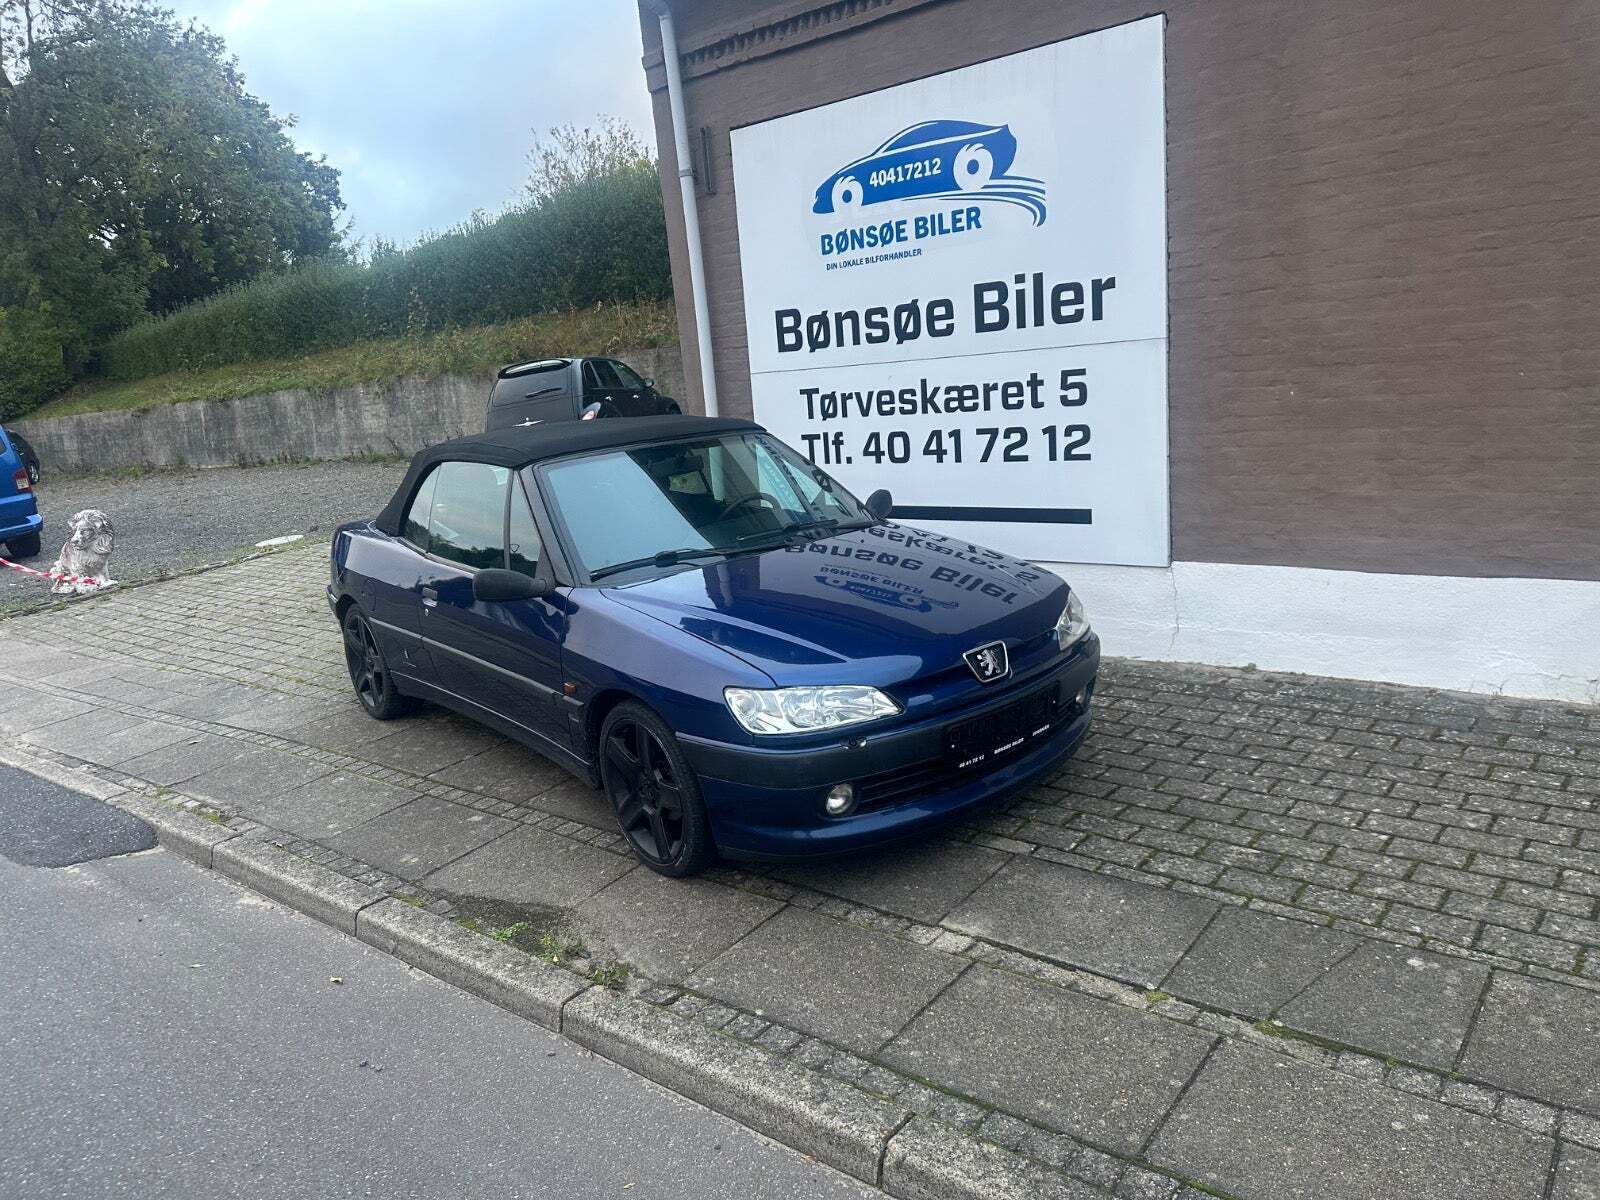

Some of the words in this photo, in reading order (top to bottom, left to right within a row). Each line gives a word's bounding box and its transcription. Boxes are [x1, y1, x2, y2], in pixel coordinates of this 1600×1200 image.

[869, 157, 942, 187] 40417212
[820, 219, 909, 256] BØNSØE
[914, 206, 982, 240] BILER
[825, 262, 838, 271] DIN
[838, 257, 865, 269] LOKALE
[864, 248, 923, 265] BILFORHANDLER
[775, 298, 955, 353] Bønsøe
[973, 271, 1116, 334] Biler
[800, 372, 1045, 422] Tørveskæret
[1059, 367, 1088, 407] 5
[800, 431, 853, 466] Tlf.
[862, 430, 911, 464] 40
[922, 428, 963, 464] 41
[975, 426, 1029, 463] 72
[1041, 423, 1092, 462] 12
